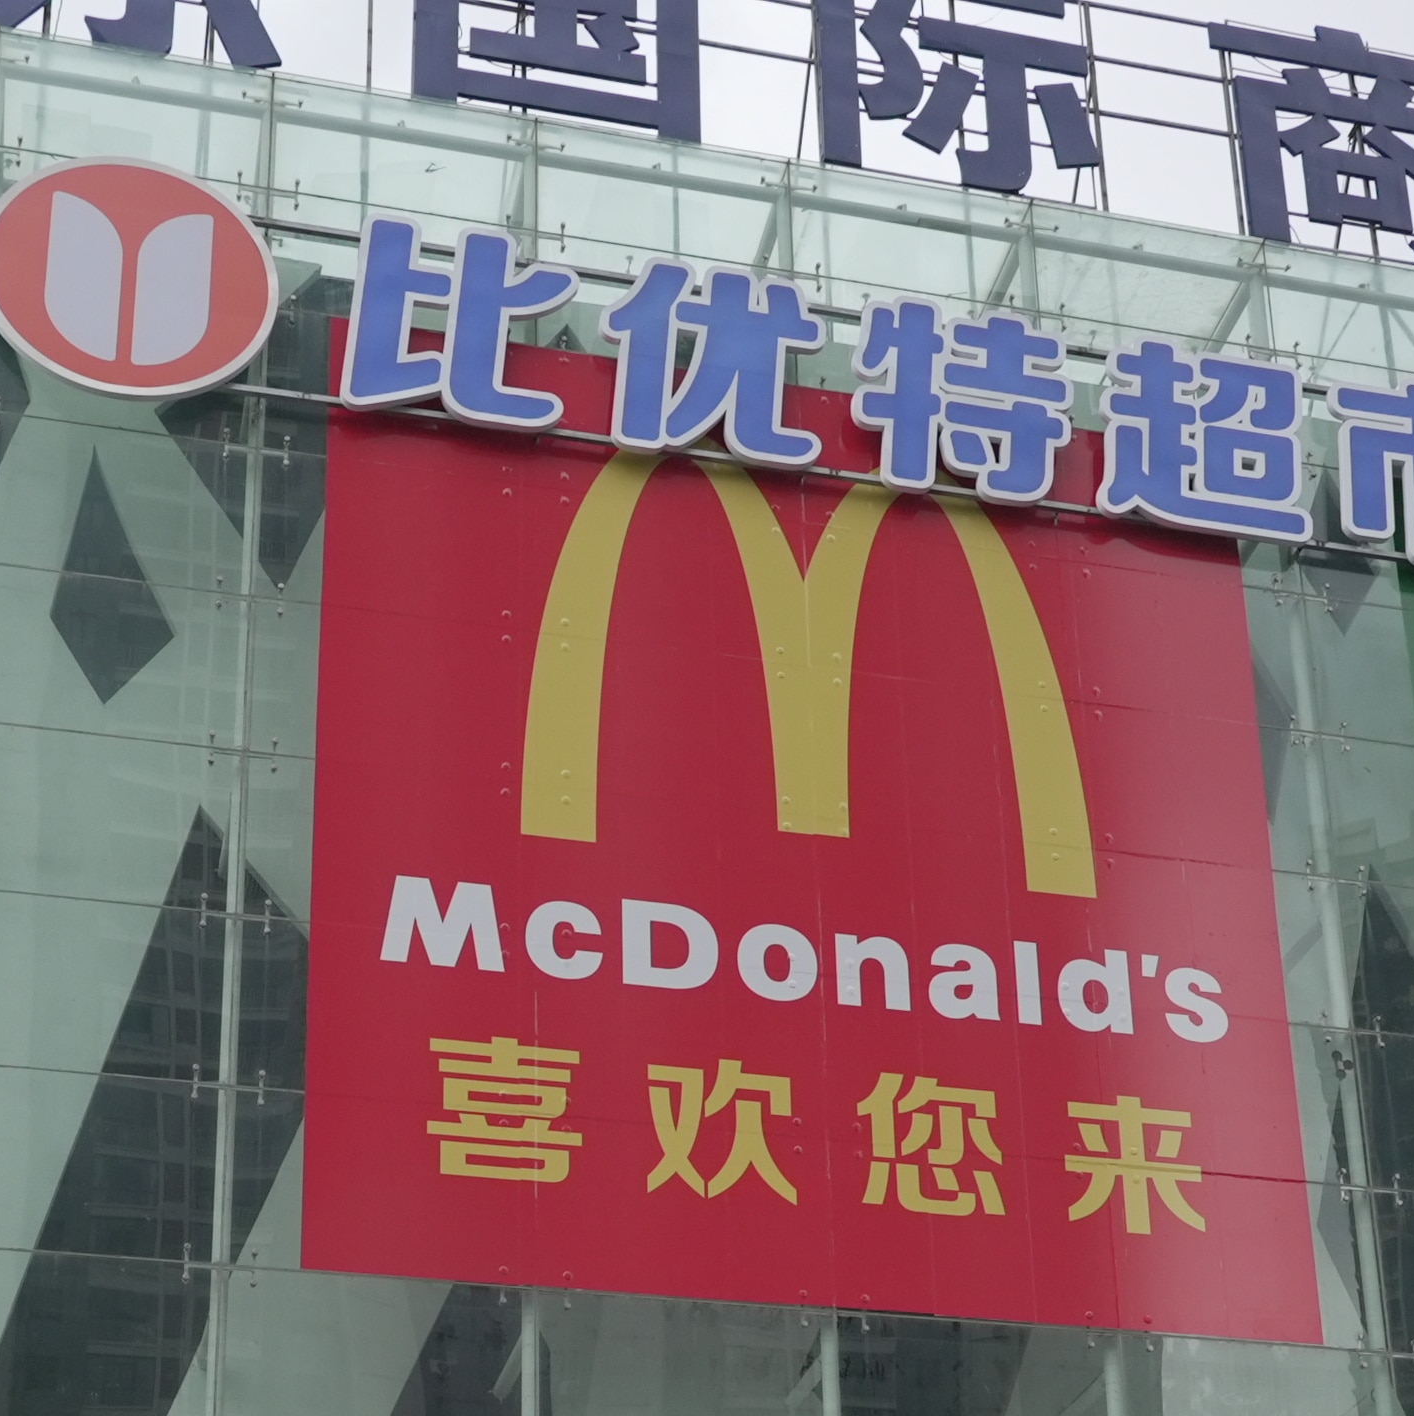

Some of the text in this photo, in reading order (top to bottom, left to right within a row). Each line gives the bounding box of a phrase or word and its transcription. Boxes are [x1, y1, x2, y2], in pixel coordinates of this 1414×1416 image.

[379, 873, 1230, 1044] McDonald's
[426, 1035, 1206, 1235] 喜欢您来
